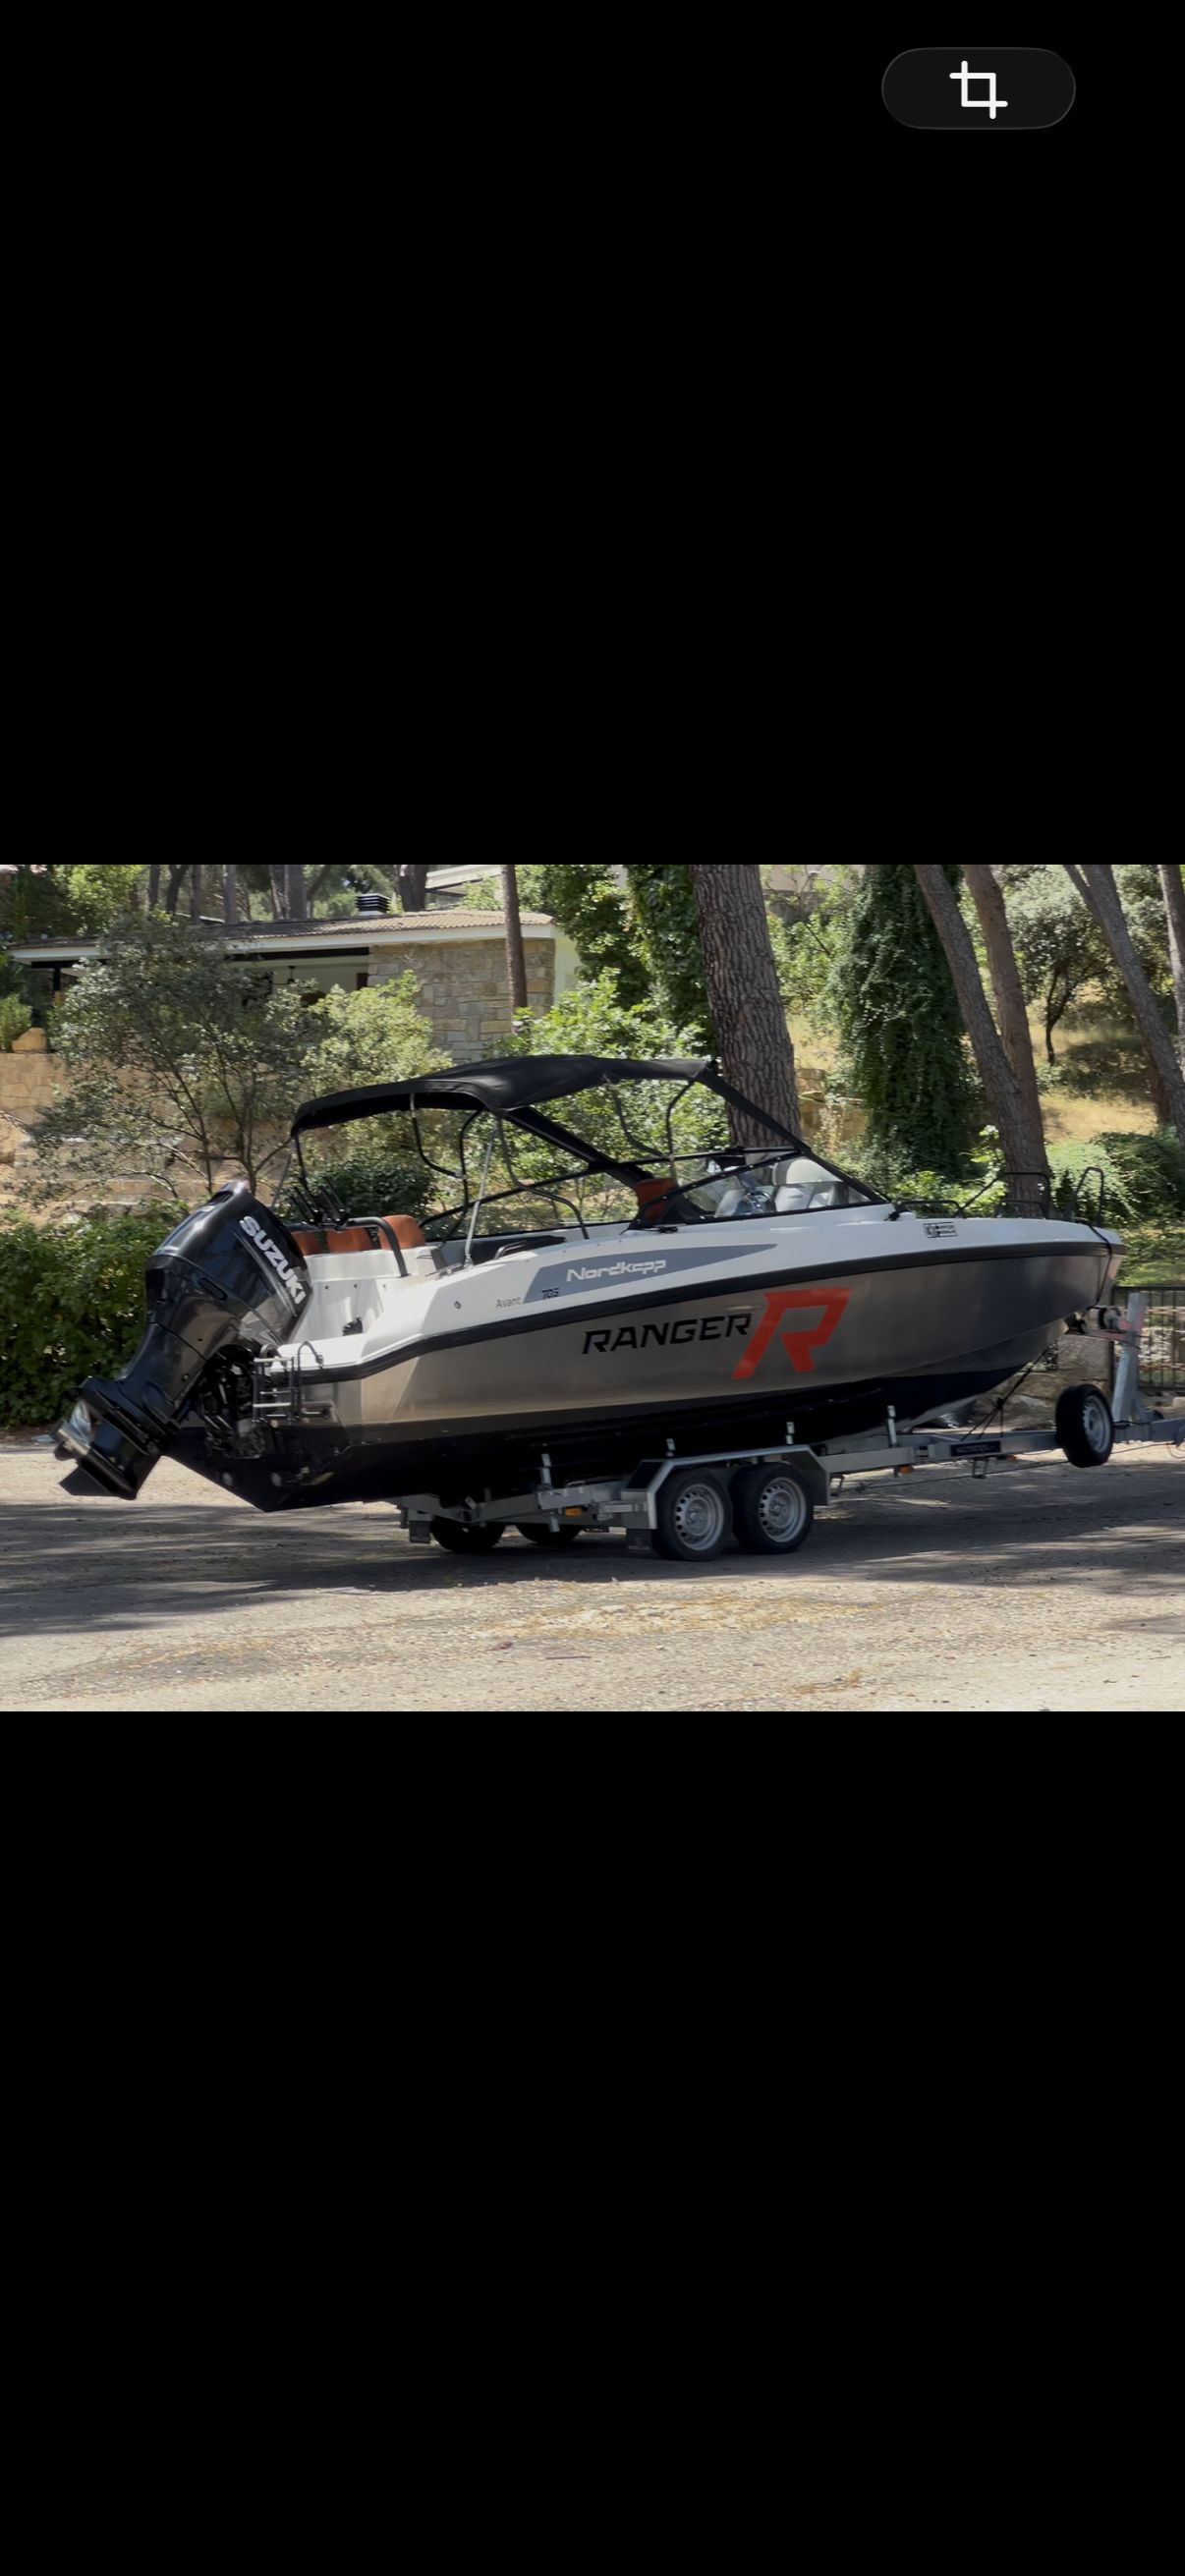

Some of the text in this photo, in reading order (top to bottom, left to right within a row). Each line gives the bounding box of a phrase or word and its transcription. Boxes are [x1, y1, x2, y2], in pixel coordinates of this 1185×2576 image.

[239, 1215, 307, 1304] SUZUKI
[582, 1287, 852, 1379] RANGER R
